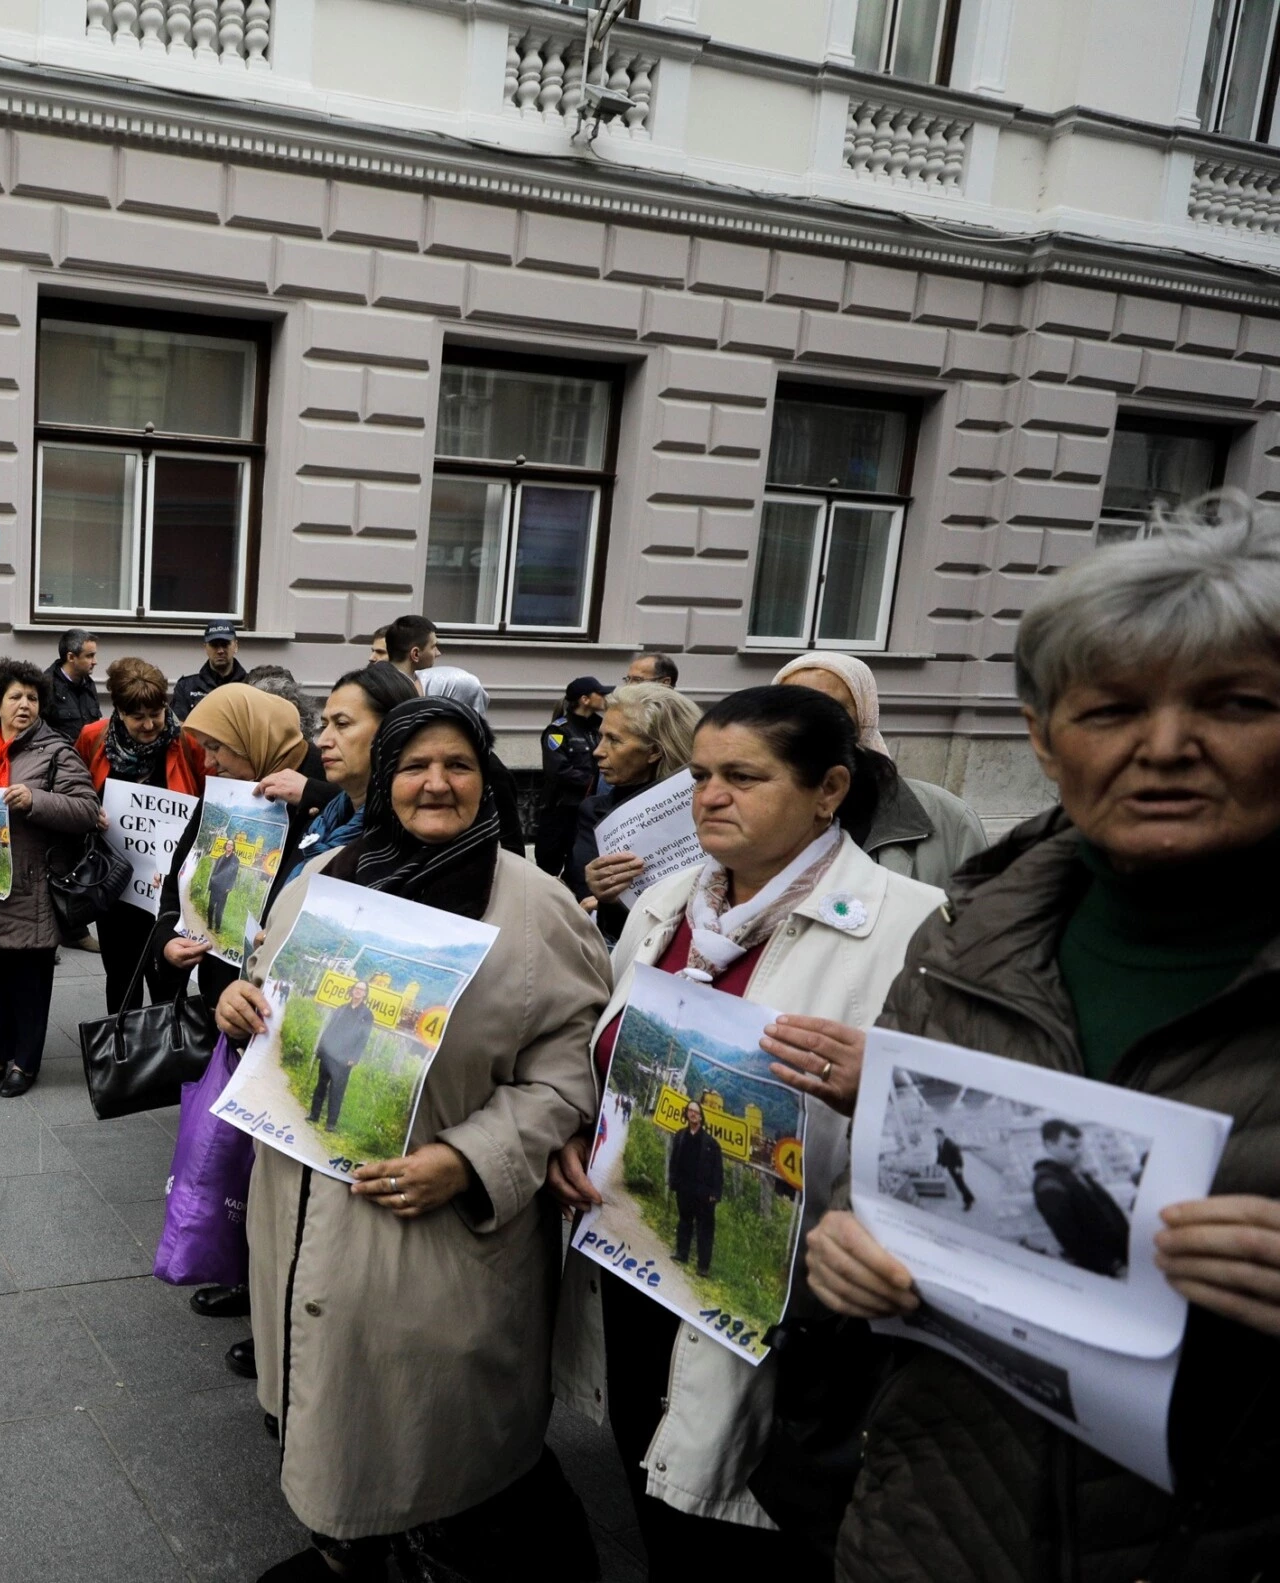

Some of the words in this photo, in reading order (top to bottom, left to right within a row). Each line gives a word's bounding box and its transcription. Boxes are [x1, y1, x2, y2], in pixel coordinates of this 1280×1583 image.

[130, 793, 191, 820] NEGIR
[603, 826, 619, 842] Govor
[620, 812, 645, 830] mržnje
[645, 798, 673, 815] Petera
[671, 783, 698, 801] Hand
[119, 814, 156, 834] GEN
[124, 837, 156, 857] POS
[609, 834, 626, 848] izjavi
[626, 829, 636, 837] za
[643, 853, 655, 862] ne
[655, 835, 692, 857] vjerujem
[657, 858, 666, 867] ni
[674, 842, 701, 858] njihov
[628, 879, 644, 890] One
[645, 874, 657, 882] su
[656, 863, 680, 878] samo
[680, 851, 708, 867] odvrat
[134, 880, 155, 900] GE
[217, 1100, 295, 1144] proljeće
[578, 1231, 661, 1288] proljeće
[699, 1308, 758, 1353] 1996.
